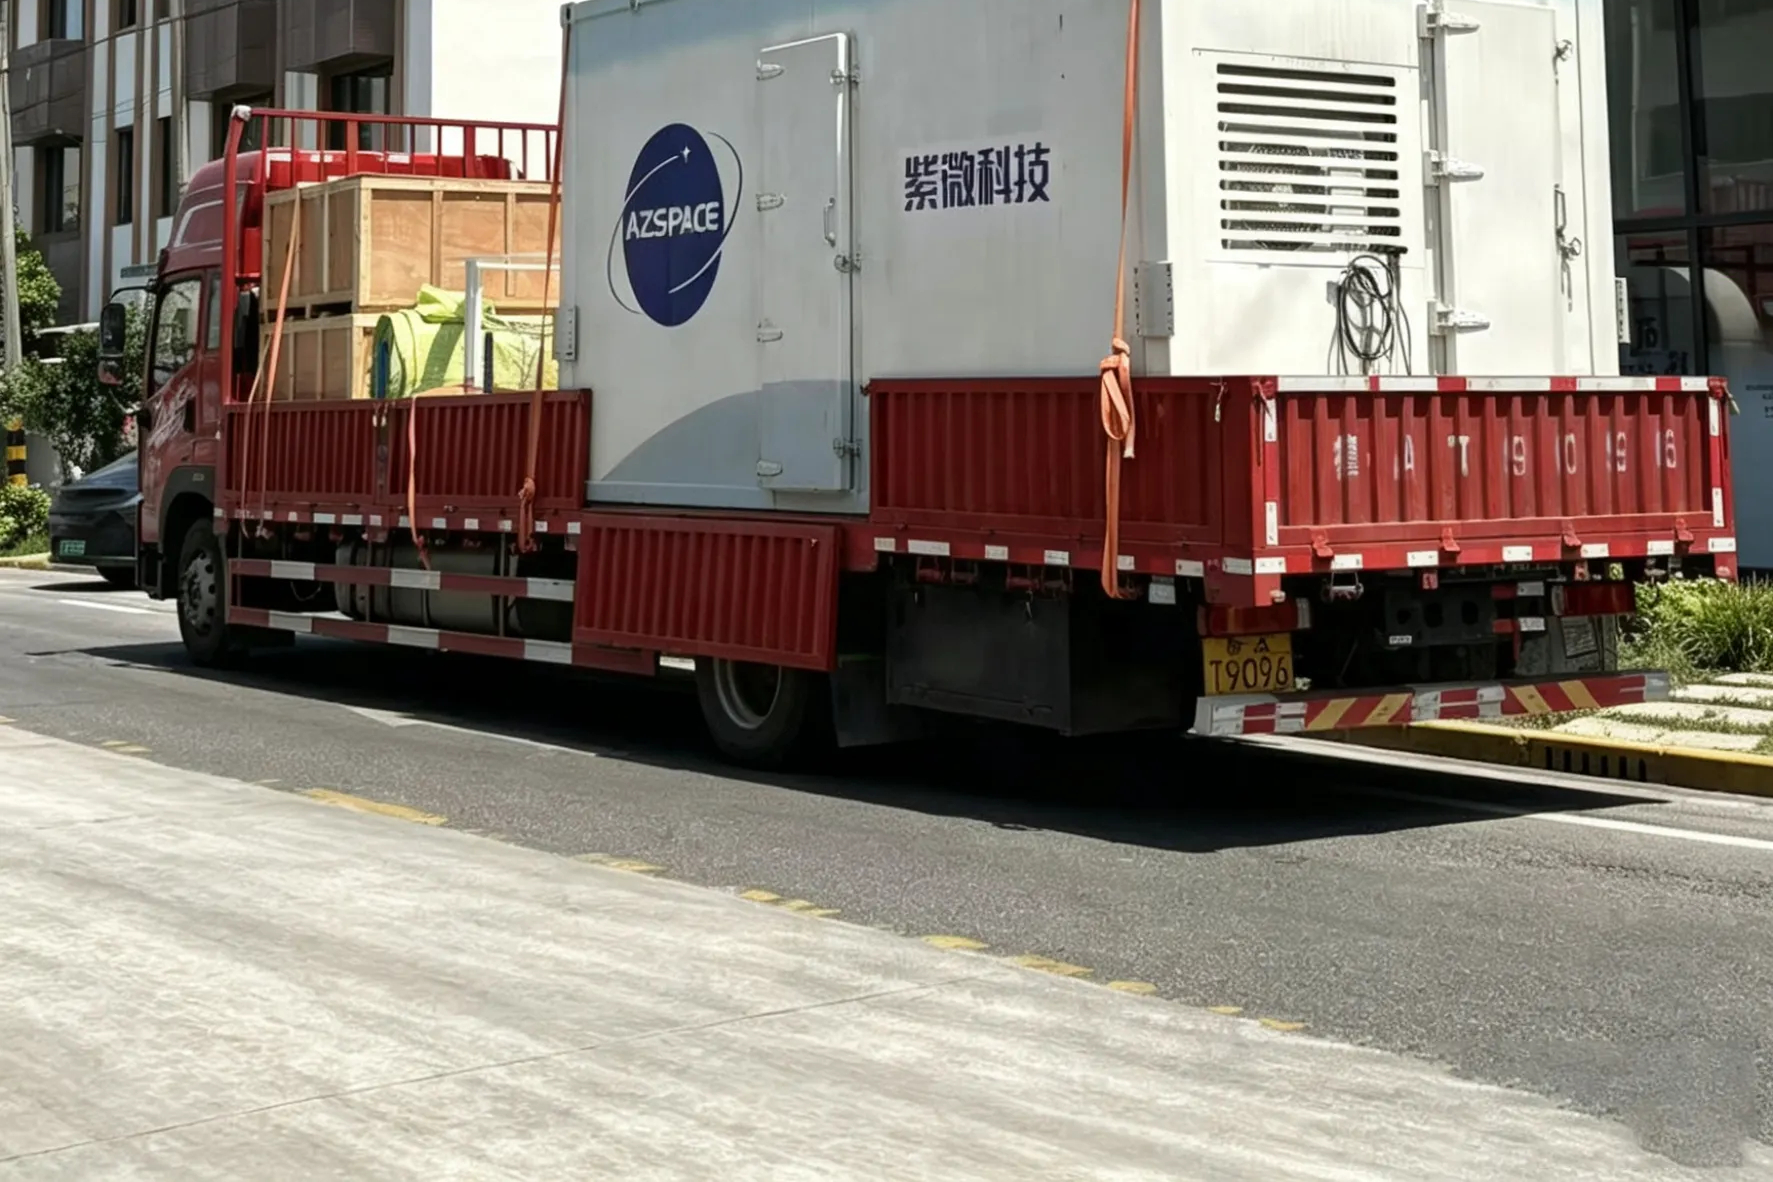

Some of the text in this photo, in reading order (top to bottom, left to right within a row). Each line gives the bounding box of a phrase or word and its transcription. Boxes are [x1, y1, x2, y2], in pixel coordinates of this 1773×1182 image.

[904, 142, 1051, 212] 紫微科技
[625, 201, 720, 240] AZSPACE
[1209, 656, 1289, 692] T9096
